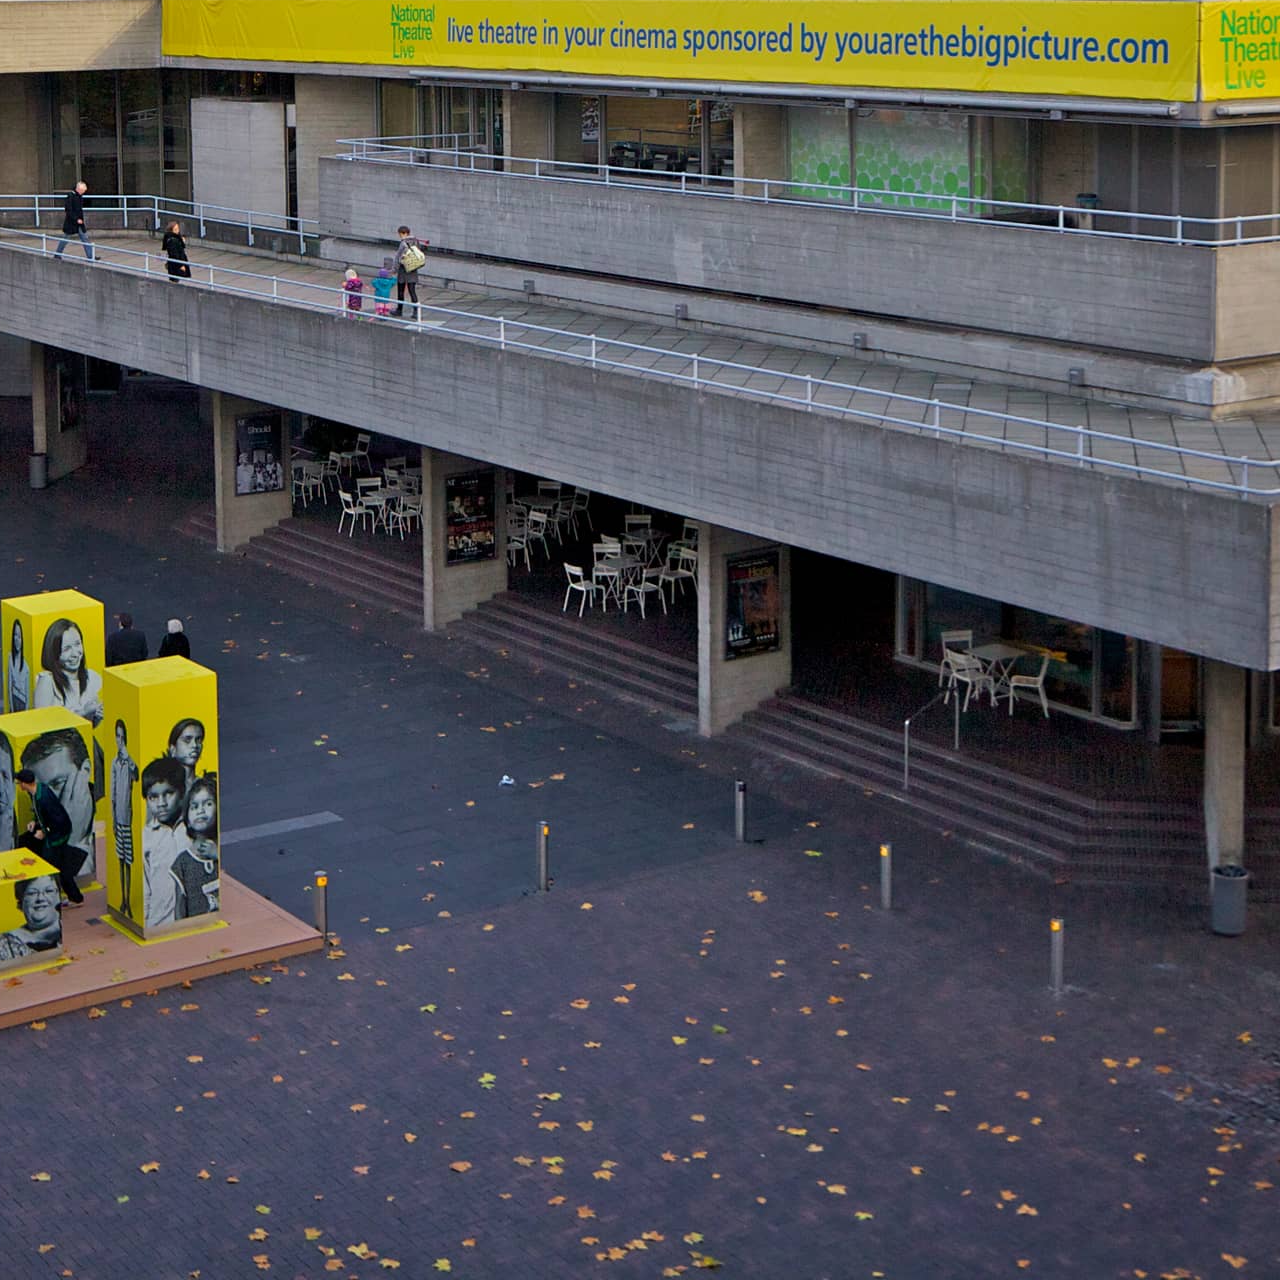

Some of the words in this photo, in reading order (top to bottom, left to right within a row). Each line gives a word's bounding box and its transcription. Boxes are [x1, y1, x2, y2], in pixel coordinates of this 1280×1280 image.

[391, 3, 435, 21] National
[391, 22, 432, 42] Theatre
[447, 16, 474, 43] live
[478, 17, 537, 45] theatre
[543, 19, 558, 45] in
[564, 25, 605, 53] your
[610, 20, 677, 49] cinema
[683, 22, 793, 57] sponsored
[800, 22, 828, 61] by
[834, 23, 1169, 67] youarethebigpicture.com
[393, 40, 415, 59] Live
[1225, 62, 1266, 89] Live
